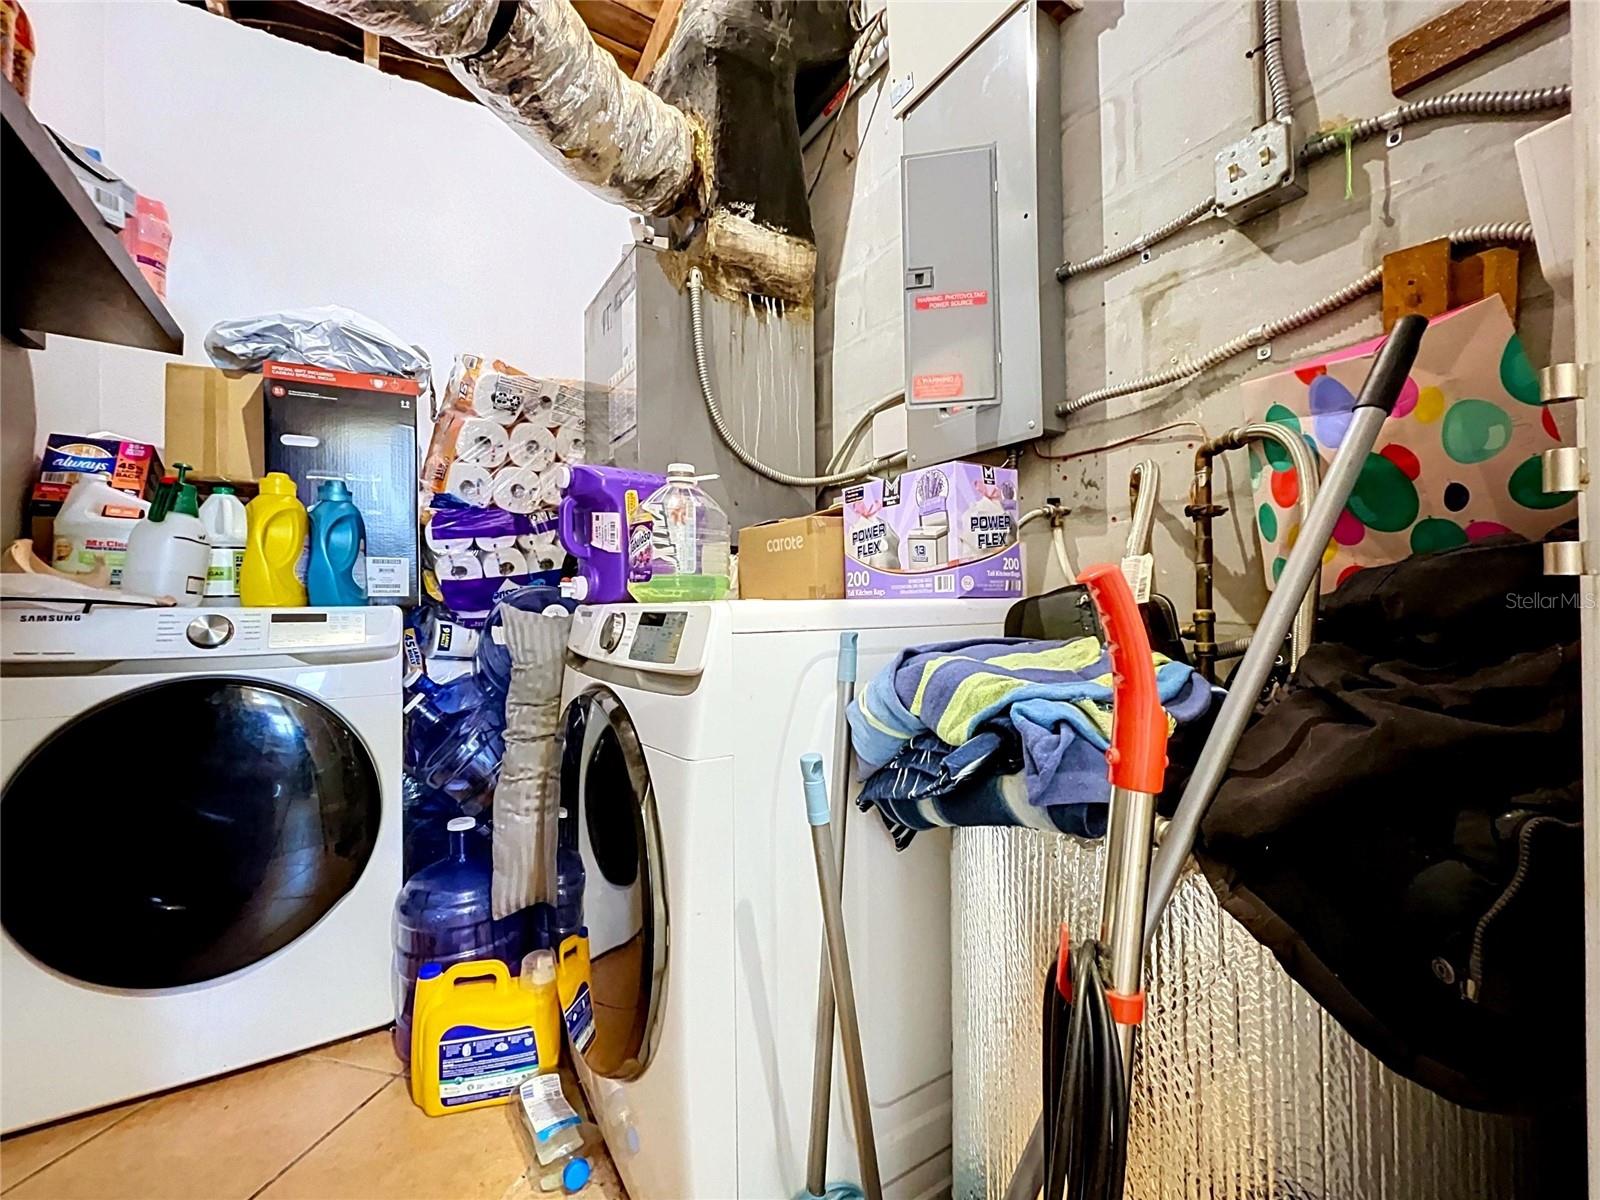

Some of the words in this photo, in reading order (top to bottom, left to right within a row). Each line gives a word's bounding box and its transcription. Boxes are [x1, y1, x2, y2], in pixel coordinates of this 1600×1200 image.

[944, 291, 986, 300] PHOTOVOLTAIC
[950, 299, 973, 307] SOURCE
[52, 456, 109, 472] always
[970, 515, 1011, 532] POWER
[852, 523, 887, 545] POWER
[978, 532, 1008, 549] FLEX
[766, 535, 804, 553] carote
[857, 540, 882, 559] FLEX
[914, 545, 926, 555] 13
[1003, 558, 1020, 571] 200
[847, 571, 870, 587] 200
[986, 569, 995, 577] Tall
[847, 589, 855, 597] Tall
[855, 588, 873, 596] Kitchen
[873, 588, 886, 597] Bags
[19, 614, 81, 622] SAMSUNG
[404, 634, 415, 647] 45
